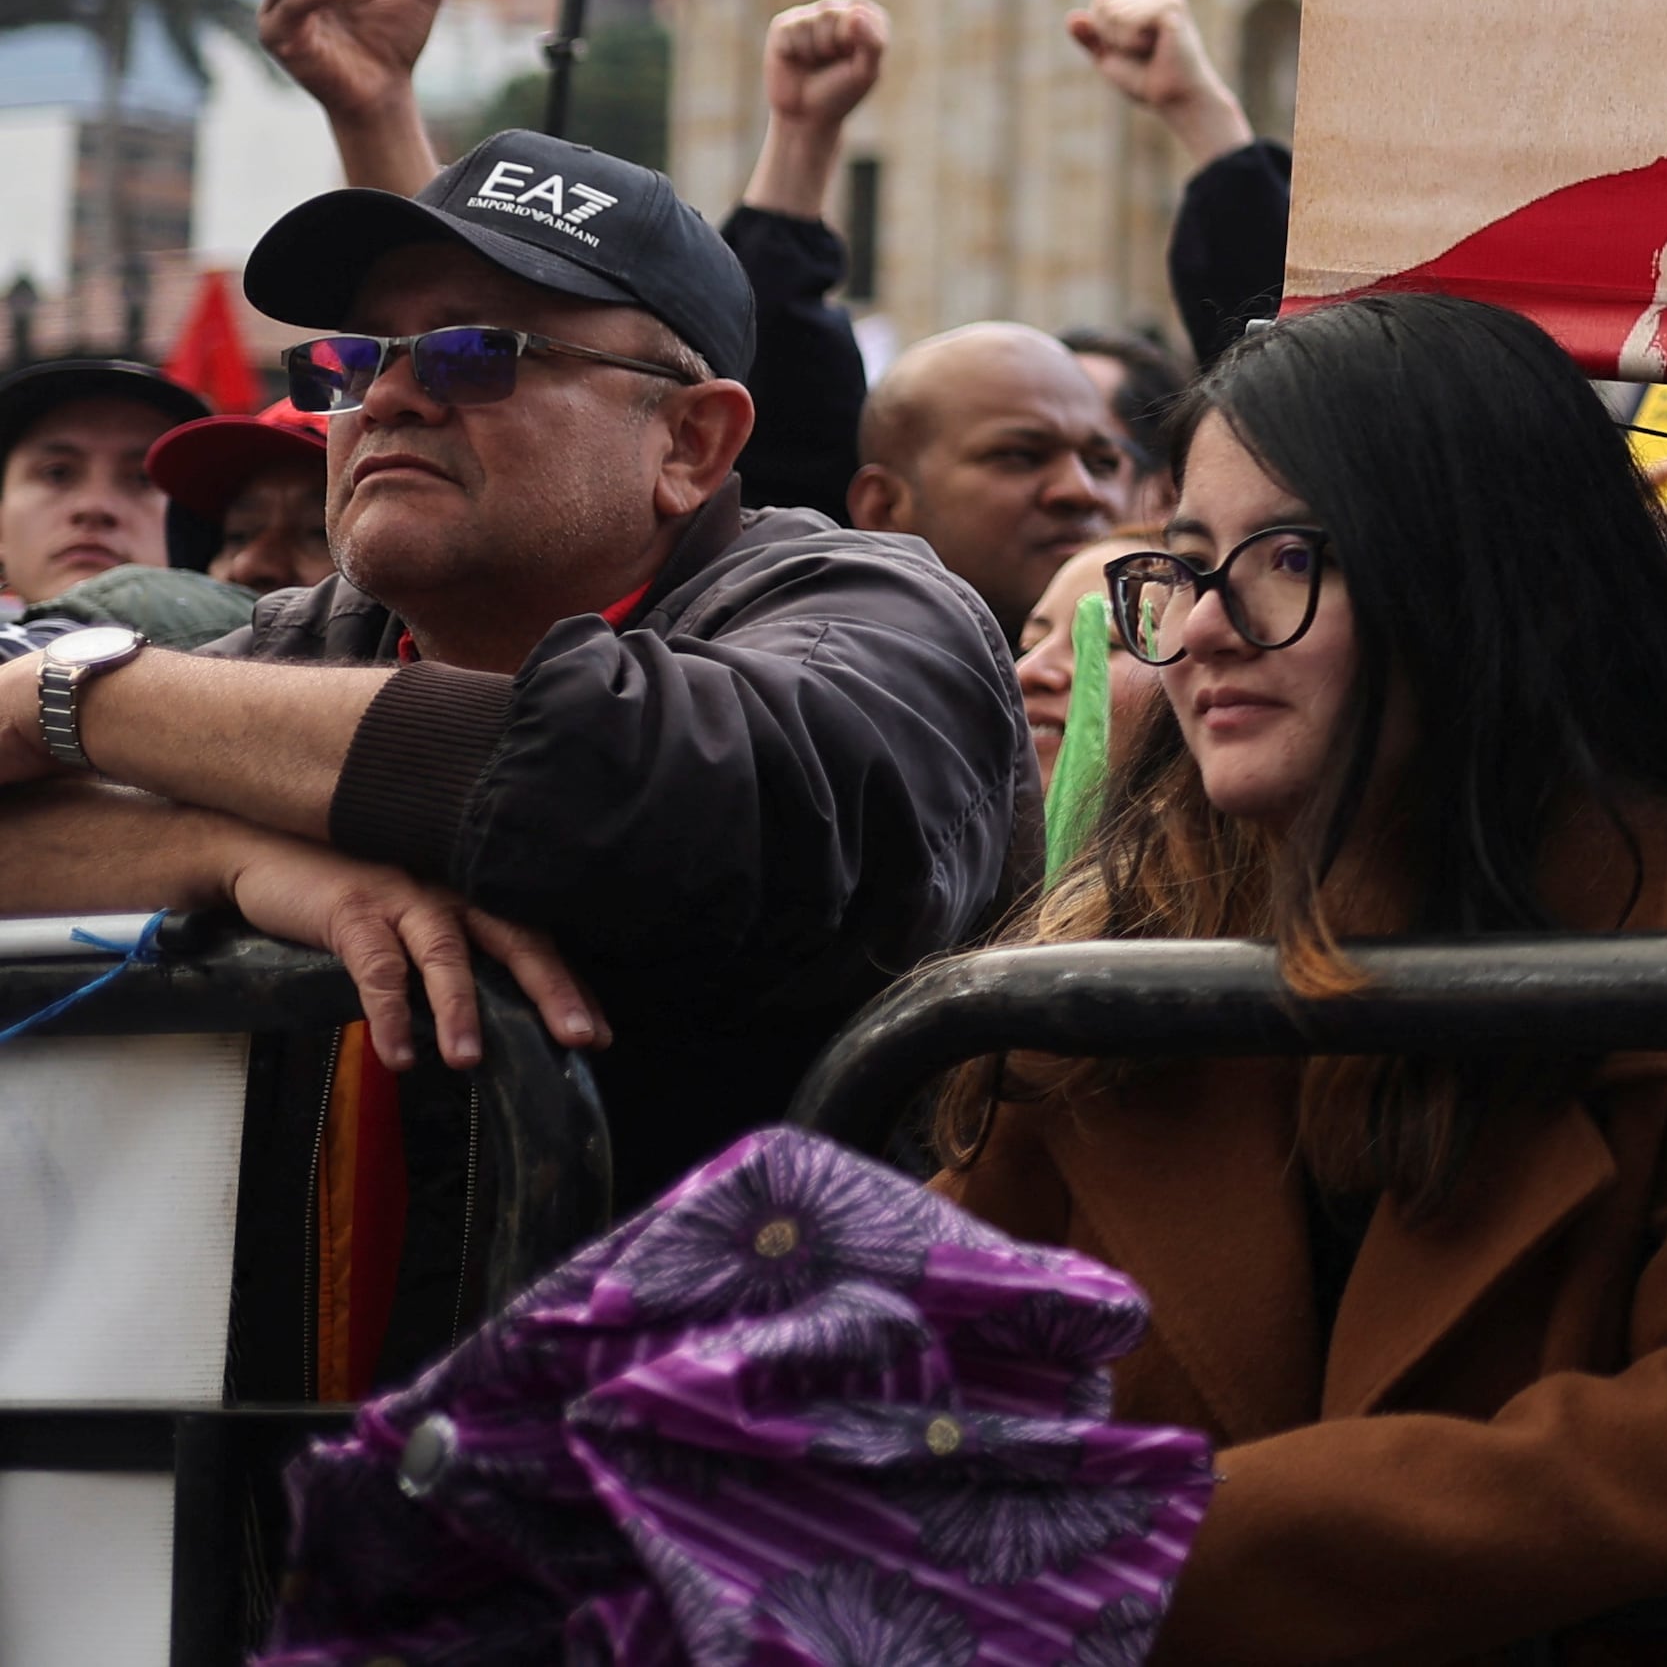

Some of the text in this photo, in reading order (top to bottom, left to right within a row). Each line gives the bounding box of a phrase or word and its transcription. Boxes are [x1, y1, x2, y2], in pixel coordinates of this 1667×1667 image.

[478, 160, 619, 224] EA7
[466, 196, 600, 248] EMPORIO ARMANI
